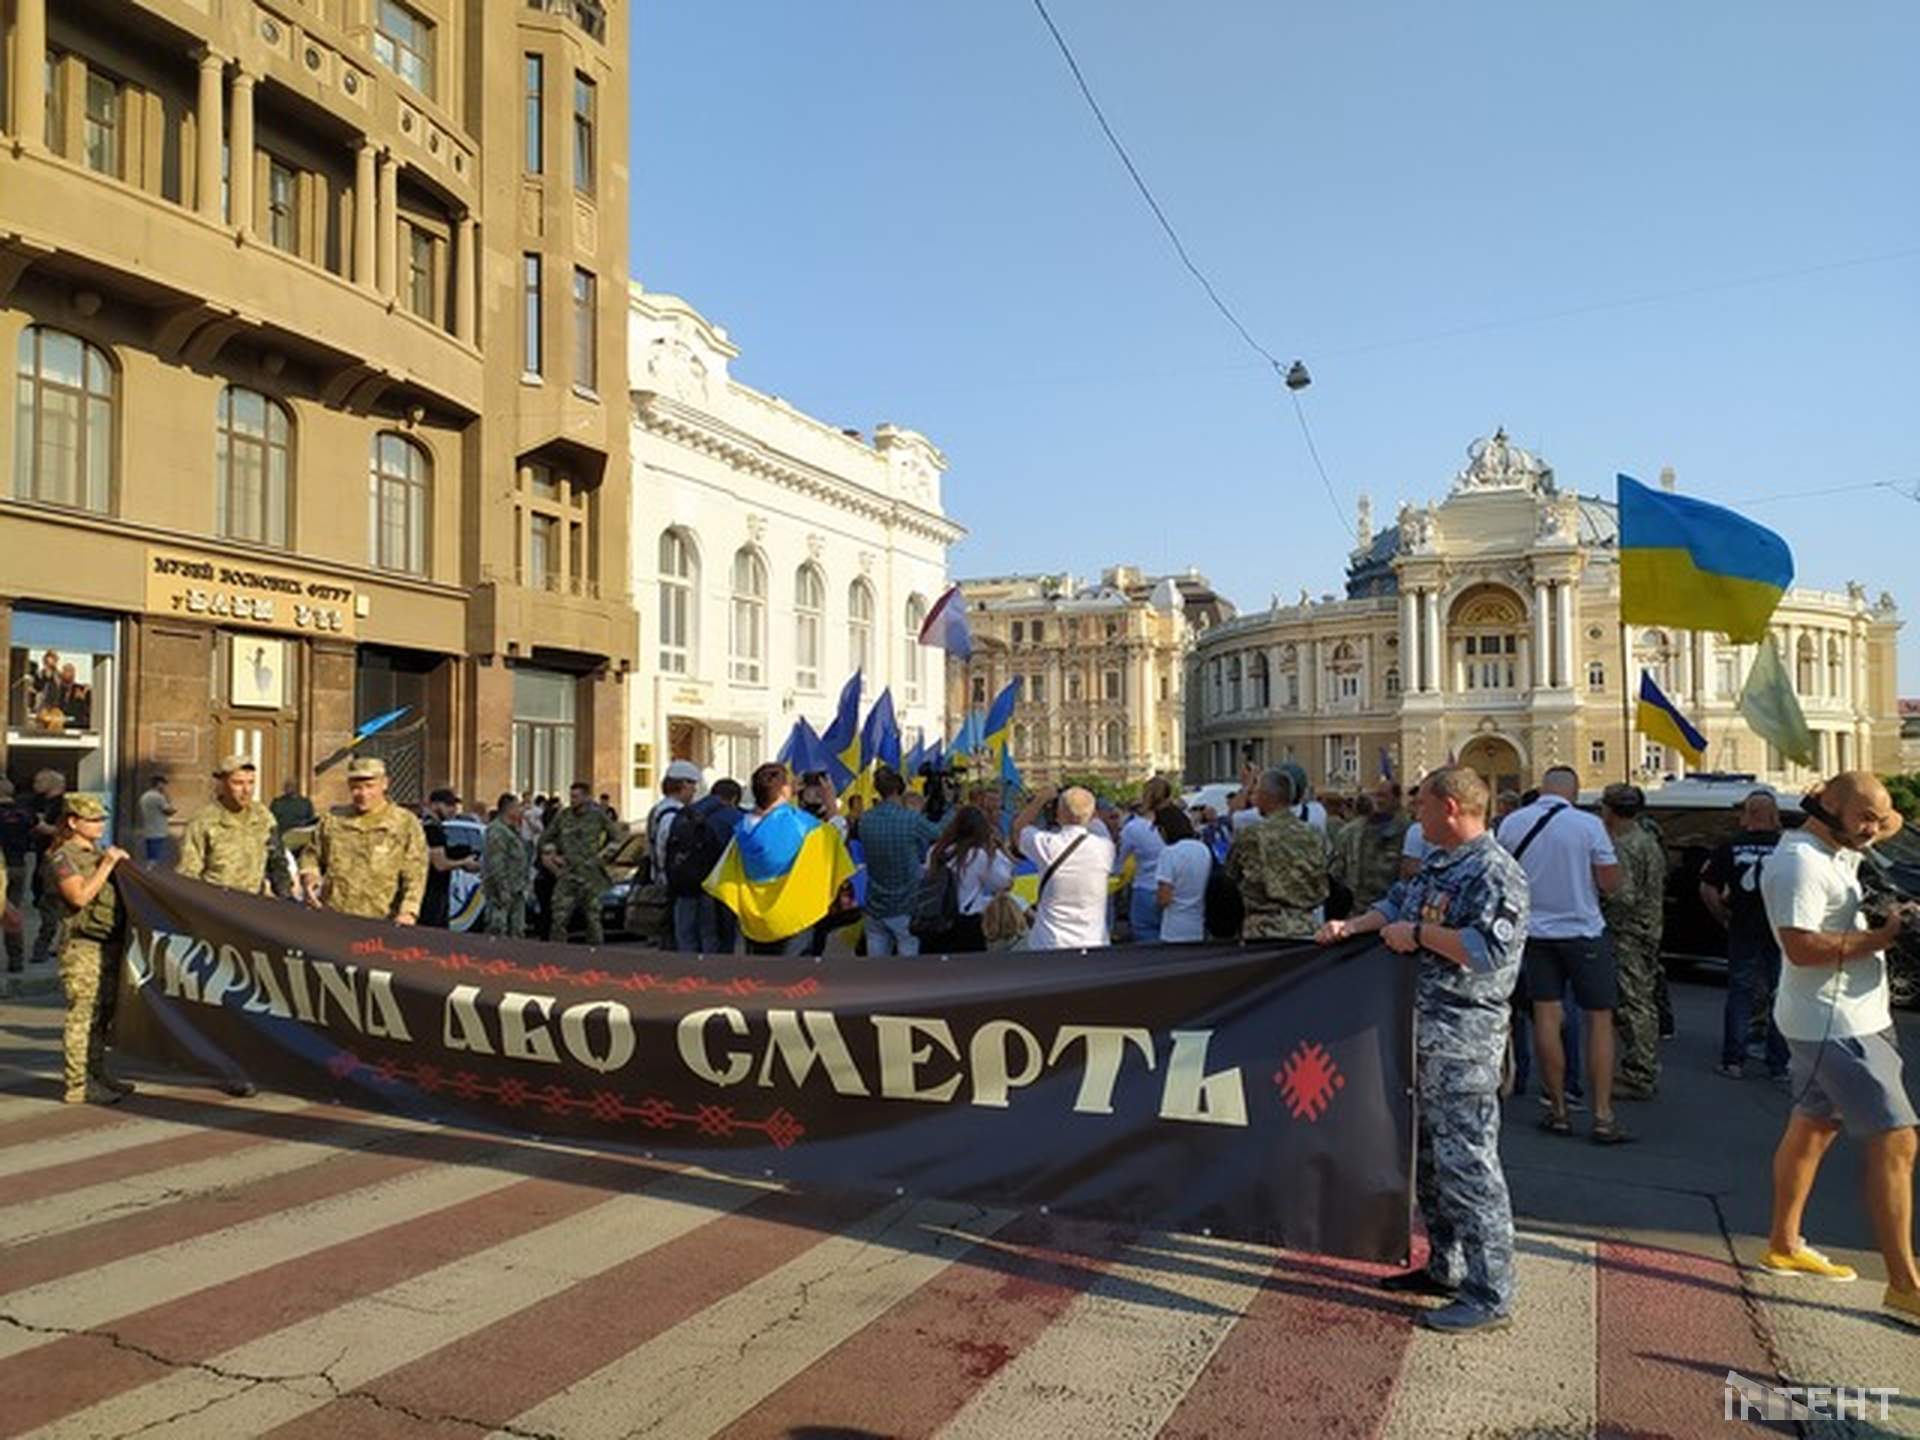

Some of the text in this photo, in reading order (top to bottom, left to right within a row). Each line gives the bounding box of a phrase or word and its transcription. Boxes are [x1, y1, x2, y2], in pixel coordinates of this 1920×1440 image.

[125, 926, 1249, 1127] УКРАЇНА АБО СМЕРТЬ
